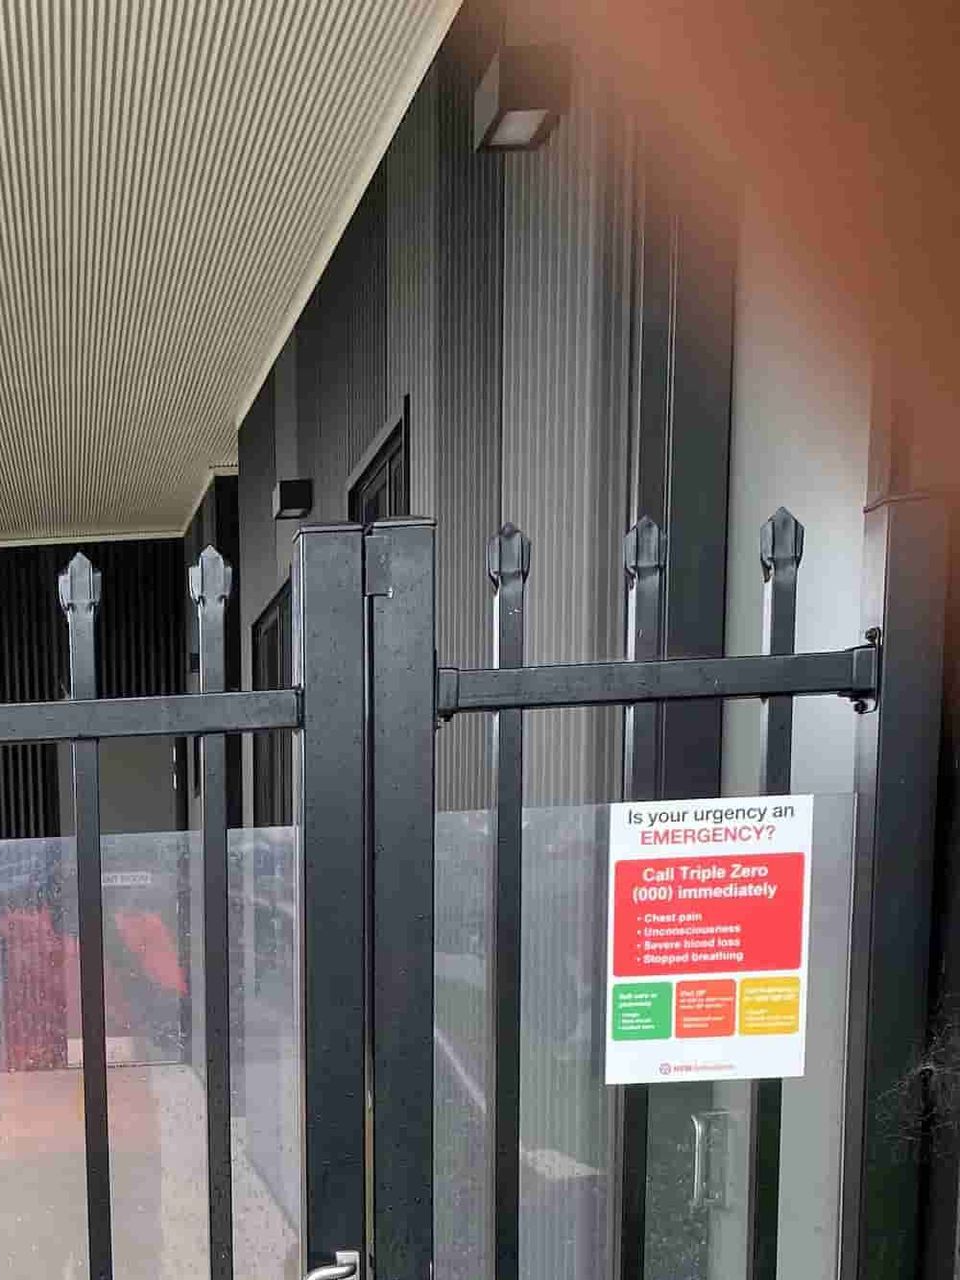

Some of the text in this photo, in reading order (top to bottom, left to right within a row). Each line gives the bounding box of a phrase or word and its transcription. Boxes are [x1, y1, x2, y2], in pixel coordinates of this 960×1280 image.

[628, 806, 794, 827] Is your urgency an
[640, 825, 776, 845] EMERGENCY?
[642, 864, 769, 883] Call Triple Zero
[632, 882, 777, 903] (000) immediately
[644, 913, 702, 924] Chest pain
[644, 925, 741, 937] Unconsciousness
[644, 938, 741, 950] Severe blood loss
[643, 951, 744, 966] Stopped breathing
